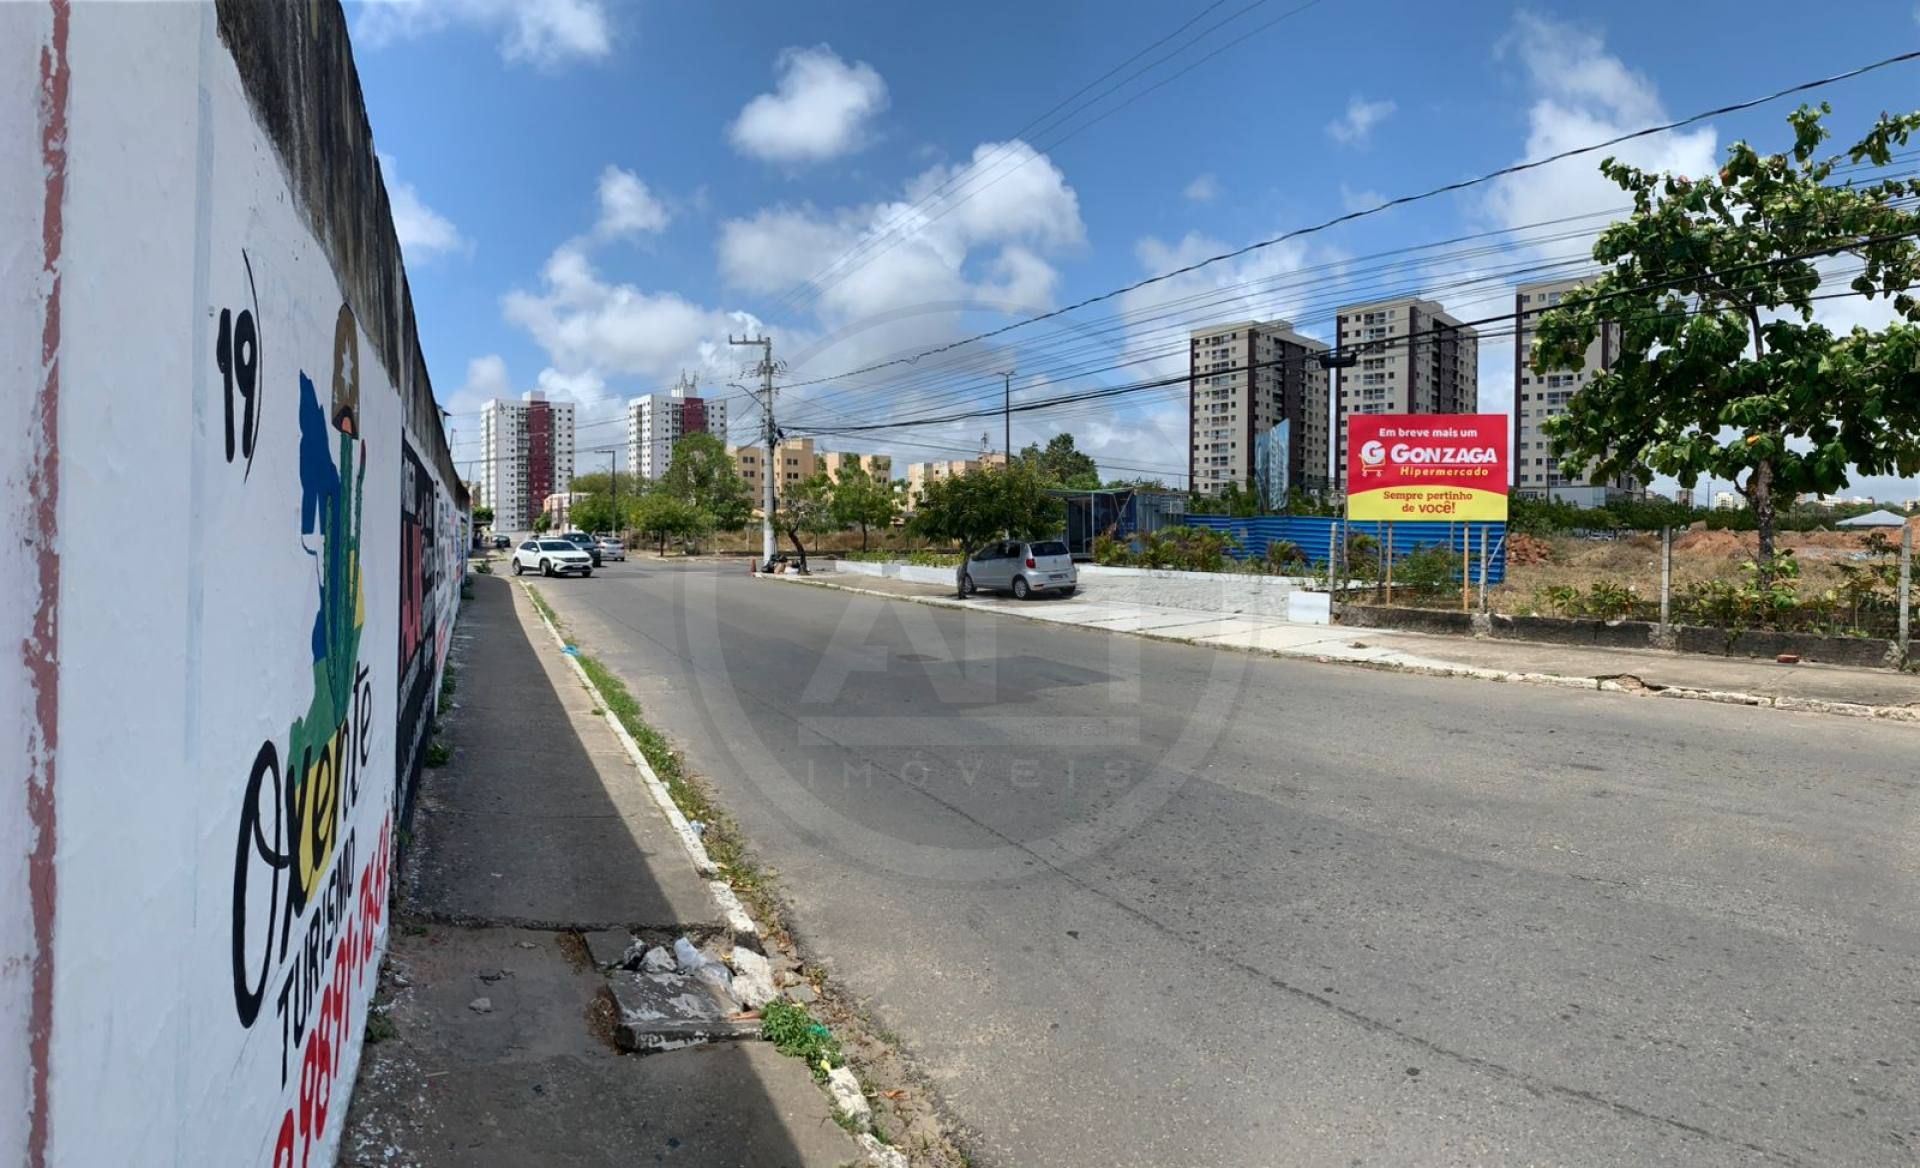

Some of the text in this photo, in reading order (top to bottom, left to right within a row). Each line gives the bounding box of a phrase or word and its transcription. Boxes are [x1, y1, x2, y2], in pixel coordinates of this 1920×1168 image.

[1379, 427, 1478, 437] Em breve mais um
[1390, 443, 1498, 464] GONZAGA
[1400, 466, 1489, 478] Hipermercado
[1383, 491, 1473, 502] Sempre pertinho
[1402, 501, 1456, 514] de você!
[277, 826, 356, 1092] TURISMO
